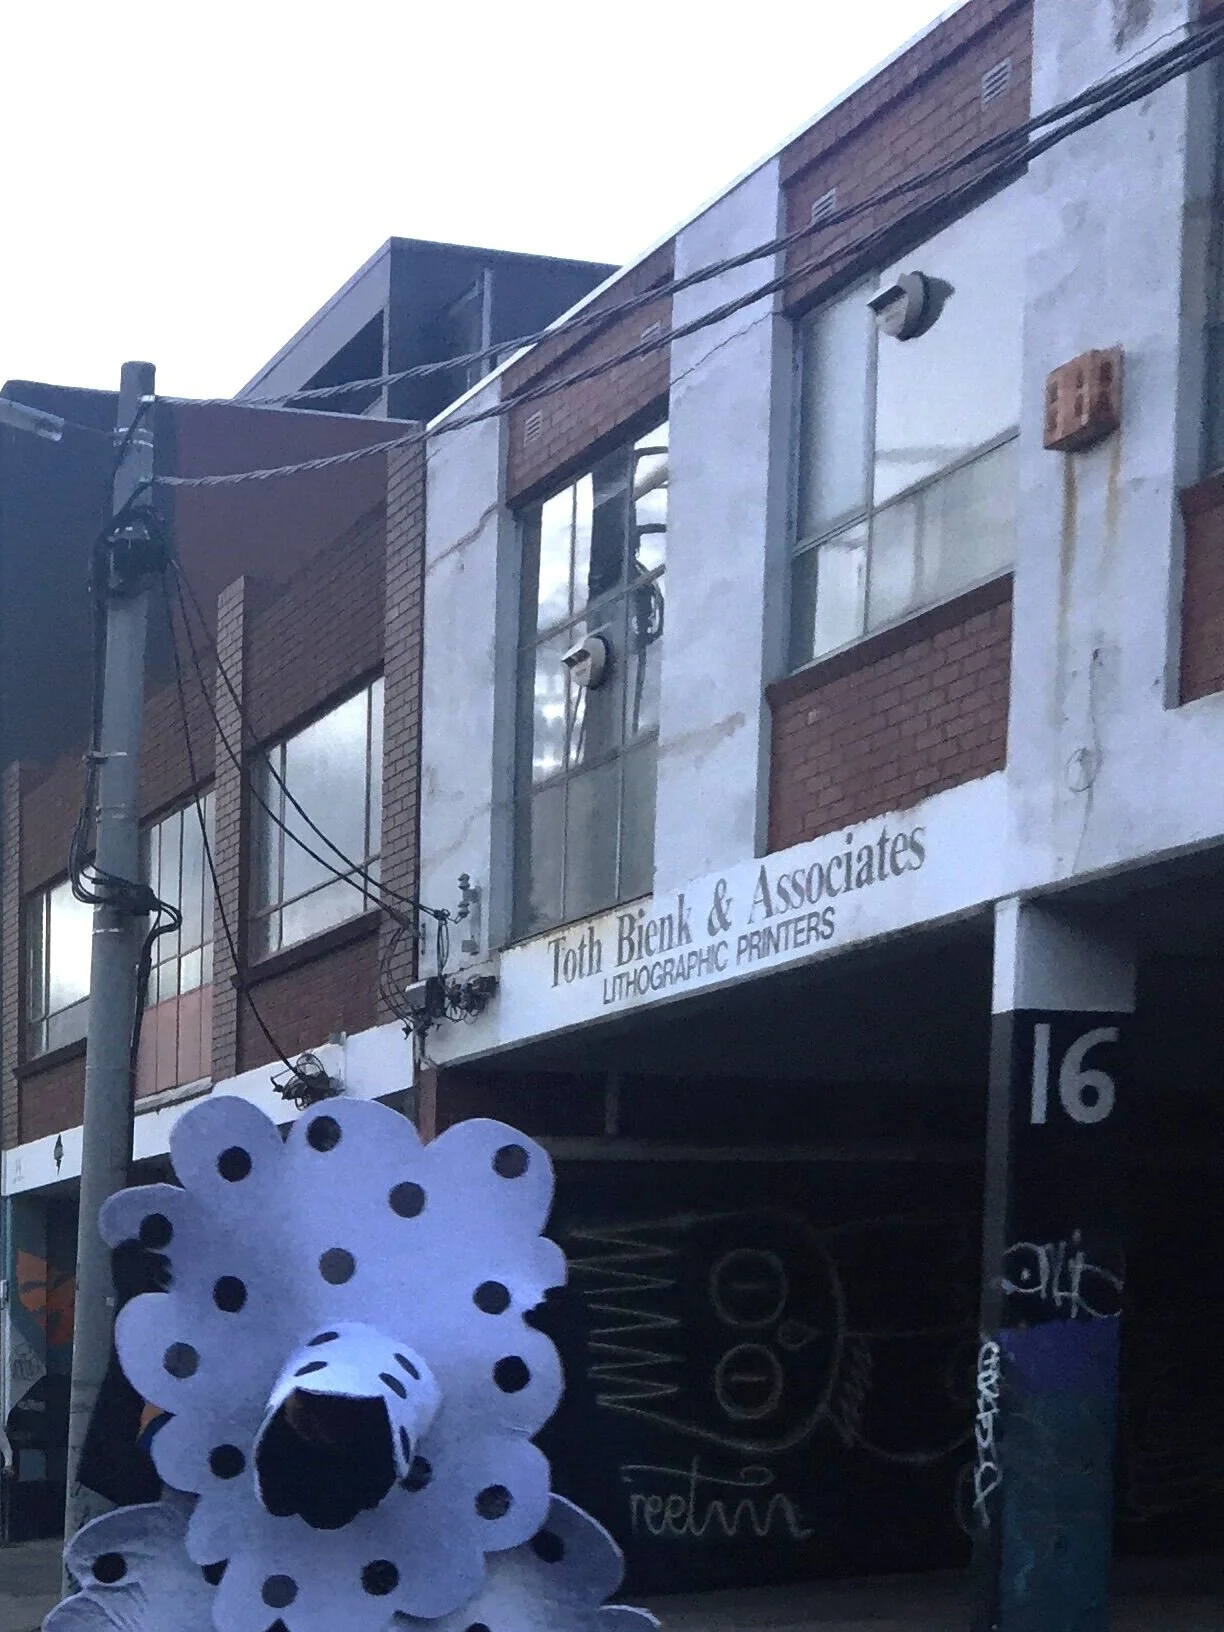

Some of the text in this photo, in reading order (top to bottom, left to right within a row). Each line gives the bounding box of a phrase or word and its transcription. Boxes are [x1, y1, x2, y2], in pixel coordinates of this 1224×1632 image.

[548, 826, 928, 989] Toth Bienk & Associates
[603, 905, 836, 1005] LITHOGRAPHIC PRINTERS
[1030, 1022, 1121, 1124] 16
